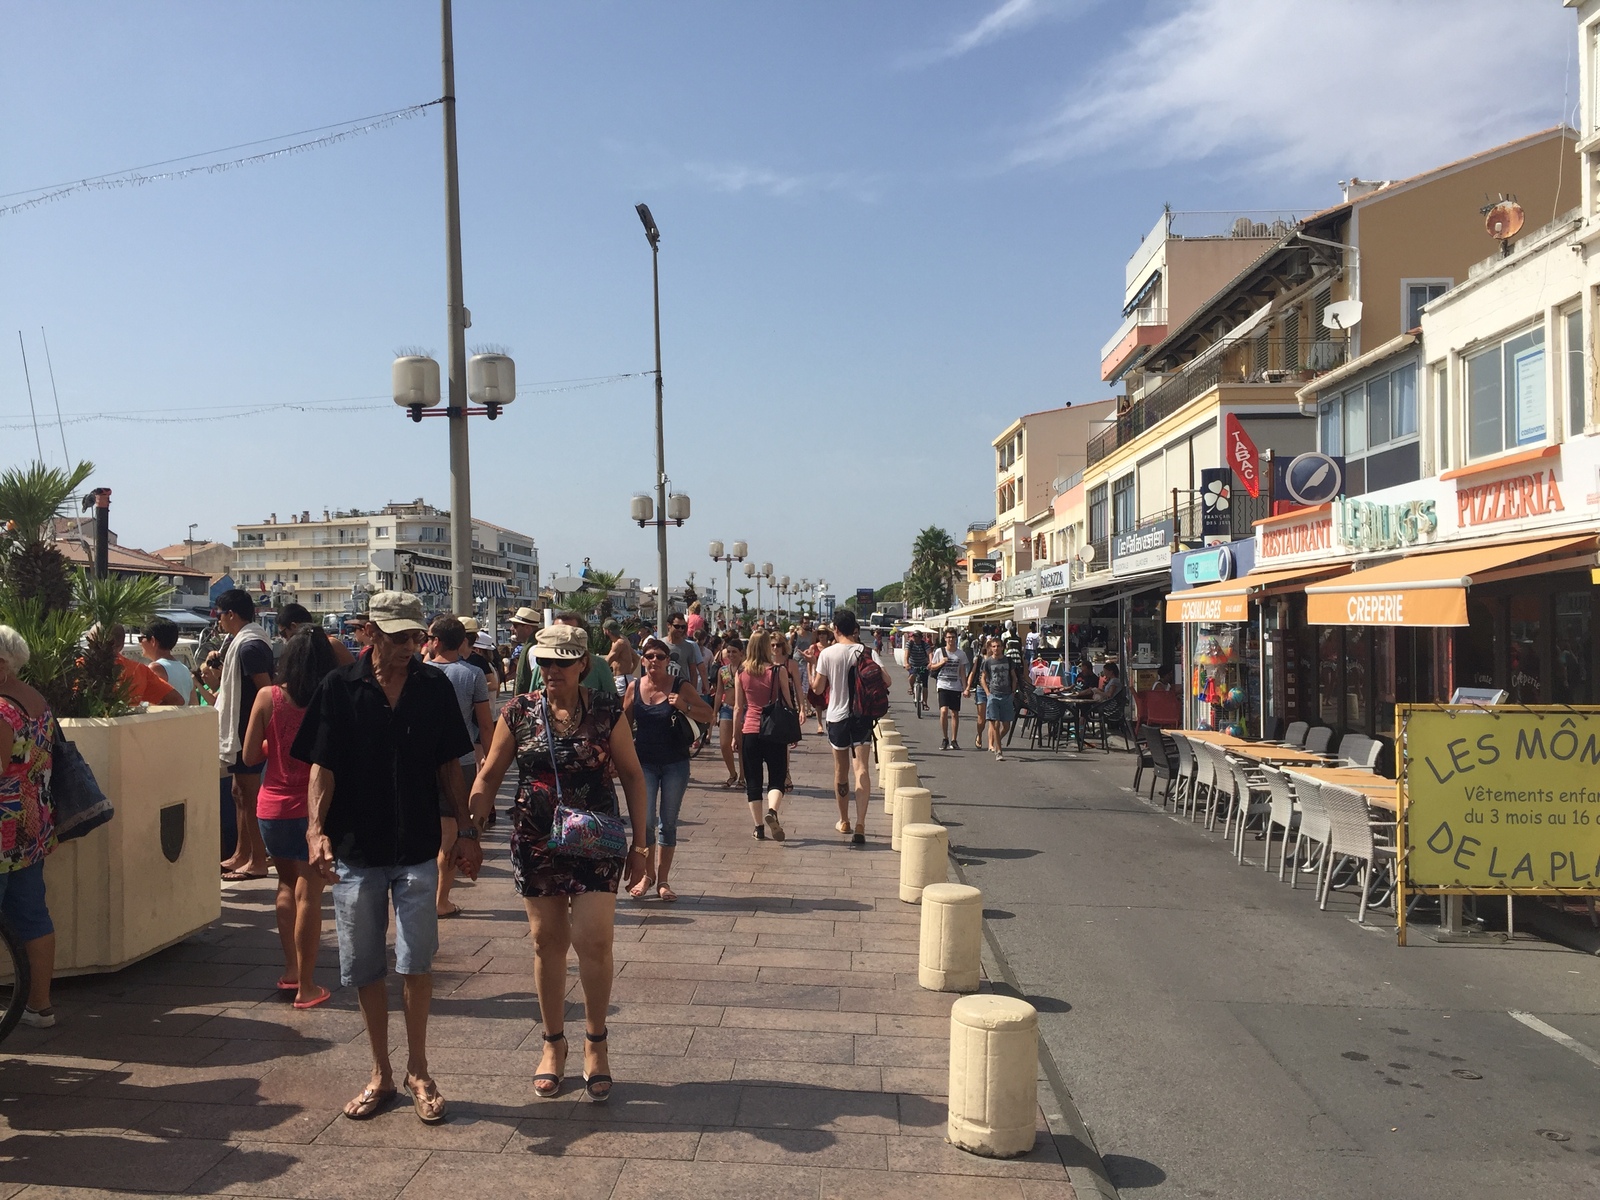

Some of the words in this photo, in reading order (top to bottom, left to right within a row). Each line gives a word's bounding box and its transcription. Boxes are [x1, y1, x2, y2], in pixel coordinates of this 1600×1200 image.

[1231, 431, 1254, 480] TABAC
[1456, 468, 1565, 529] PIZZERIA
[1262, 519, 1333, 559] RESTAURANT
[1187, 562, 1199, 579] mag
[1347, 594, 1404, 622] CREPERIE
[1425, 733, 1500, 785] LES
[1464, 786, 1553, 803] Vêtements
[1464, 808, 1484, 825] du
[1490, 808, 1499, 824] 3
[1505, 809, 1542, 825] mois
[1547, 812, 1566, 825] au
[1572, 810, 1590, 825] 16
[1426, 821, 1481, 871] DE
[1488, 846, 1534, 882] LA
[1550, 850, 1600, 882] PL
